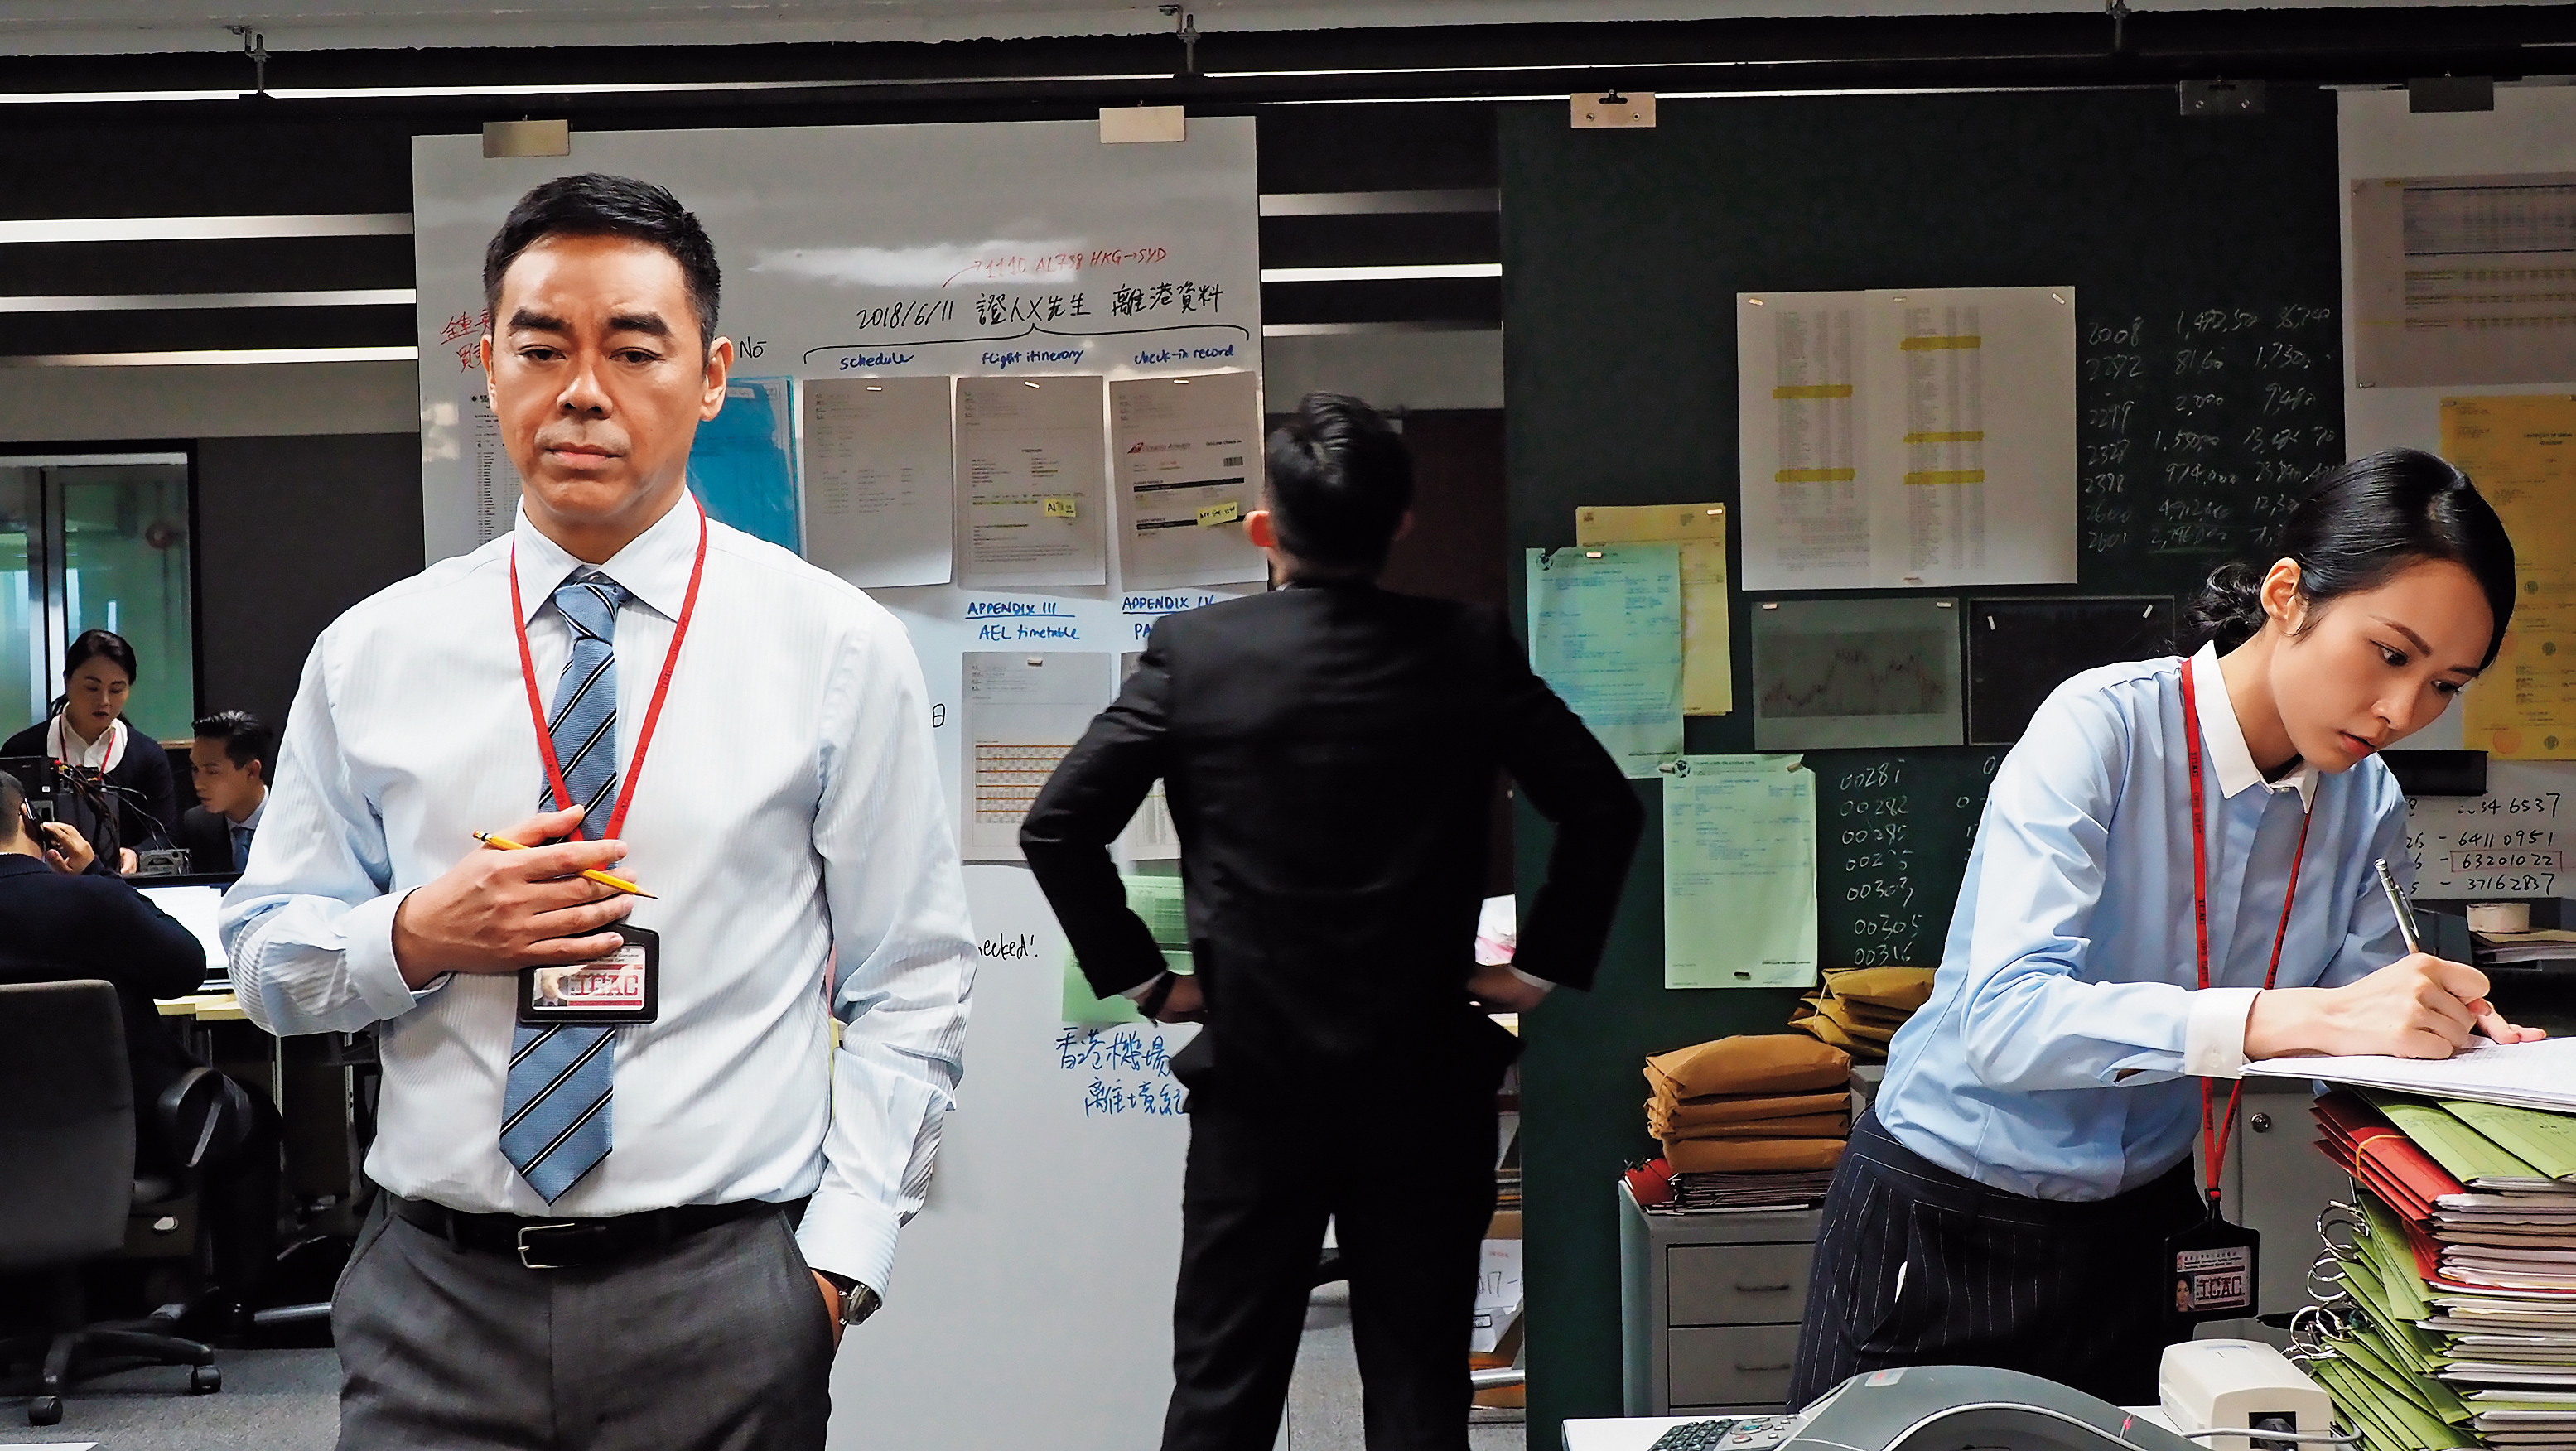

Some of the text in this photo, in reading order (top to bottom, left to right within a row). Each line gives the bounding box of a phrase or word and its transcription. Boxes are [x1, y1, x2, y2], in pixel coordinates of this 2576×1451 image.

[856, 299, 954, 330] 2018/6/11
[1192, 344, 1234, 359] record
[839, 351, 914, 371] schedule
[967, 602, 1035, 615] APPENDIX
[1122, 595, 1190, 611] APPENDIX
[979, 624, 1081, 642] AEL timetable
[1054, 1026, 1172, 1077] 香港機場
